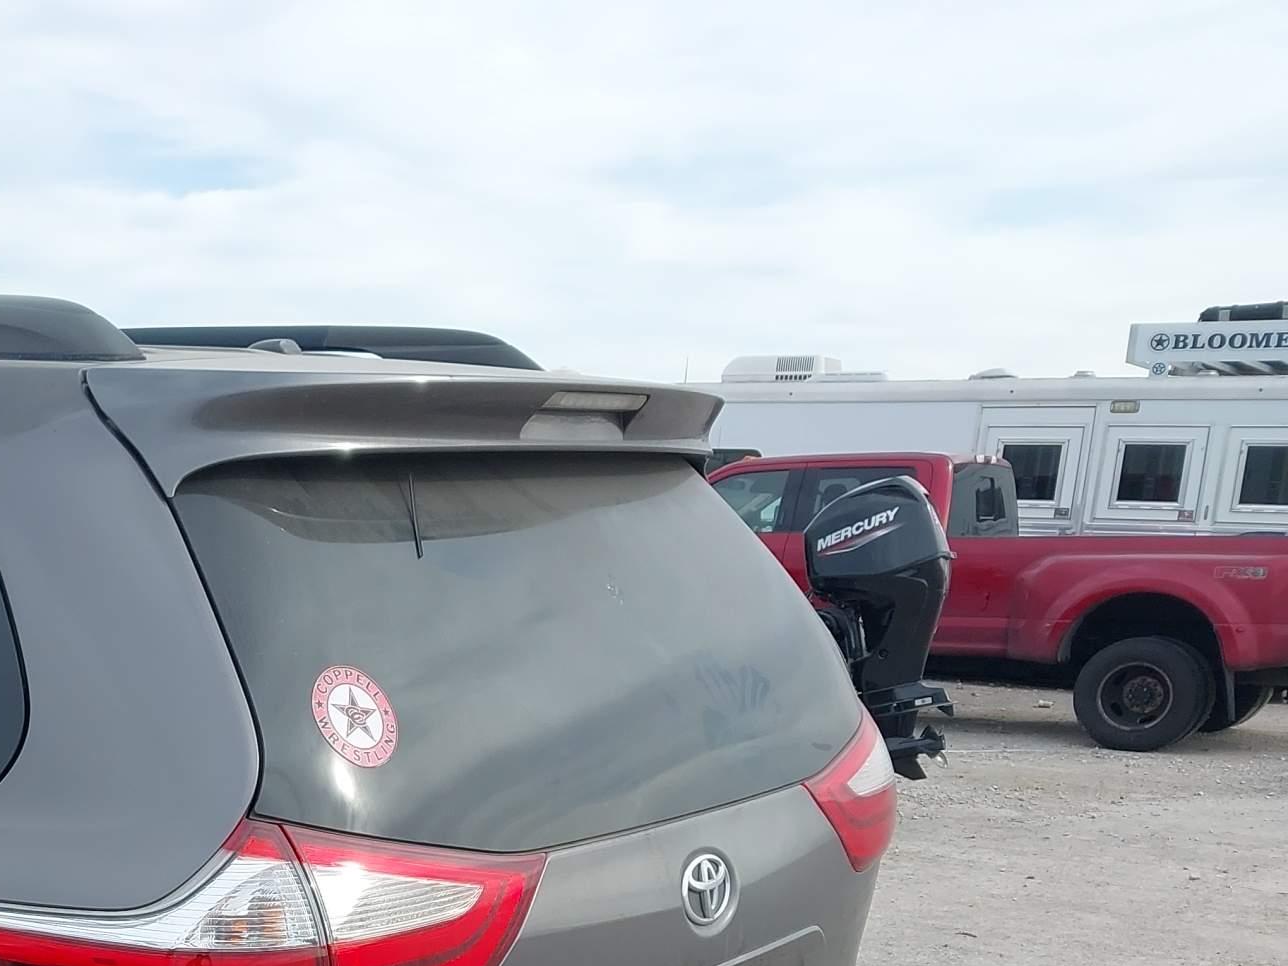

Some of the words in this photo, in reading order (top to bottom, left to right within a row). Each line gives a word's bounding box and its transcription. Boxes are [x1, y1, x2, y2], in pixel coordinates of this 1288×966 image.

[1172, 332, 1288, 350] BLOOME
[816, 506, 900, 553] MERCURY
[316, 669, 380, 702] COPPELL
[317, 716, 397, 763] WRESTLING
